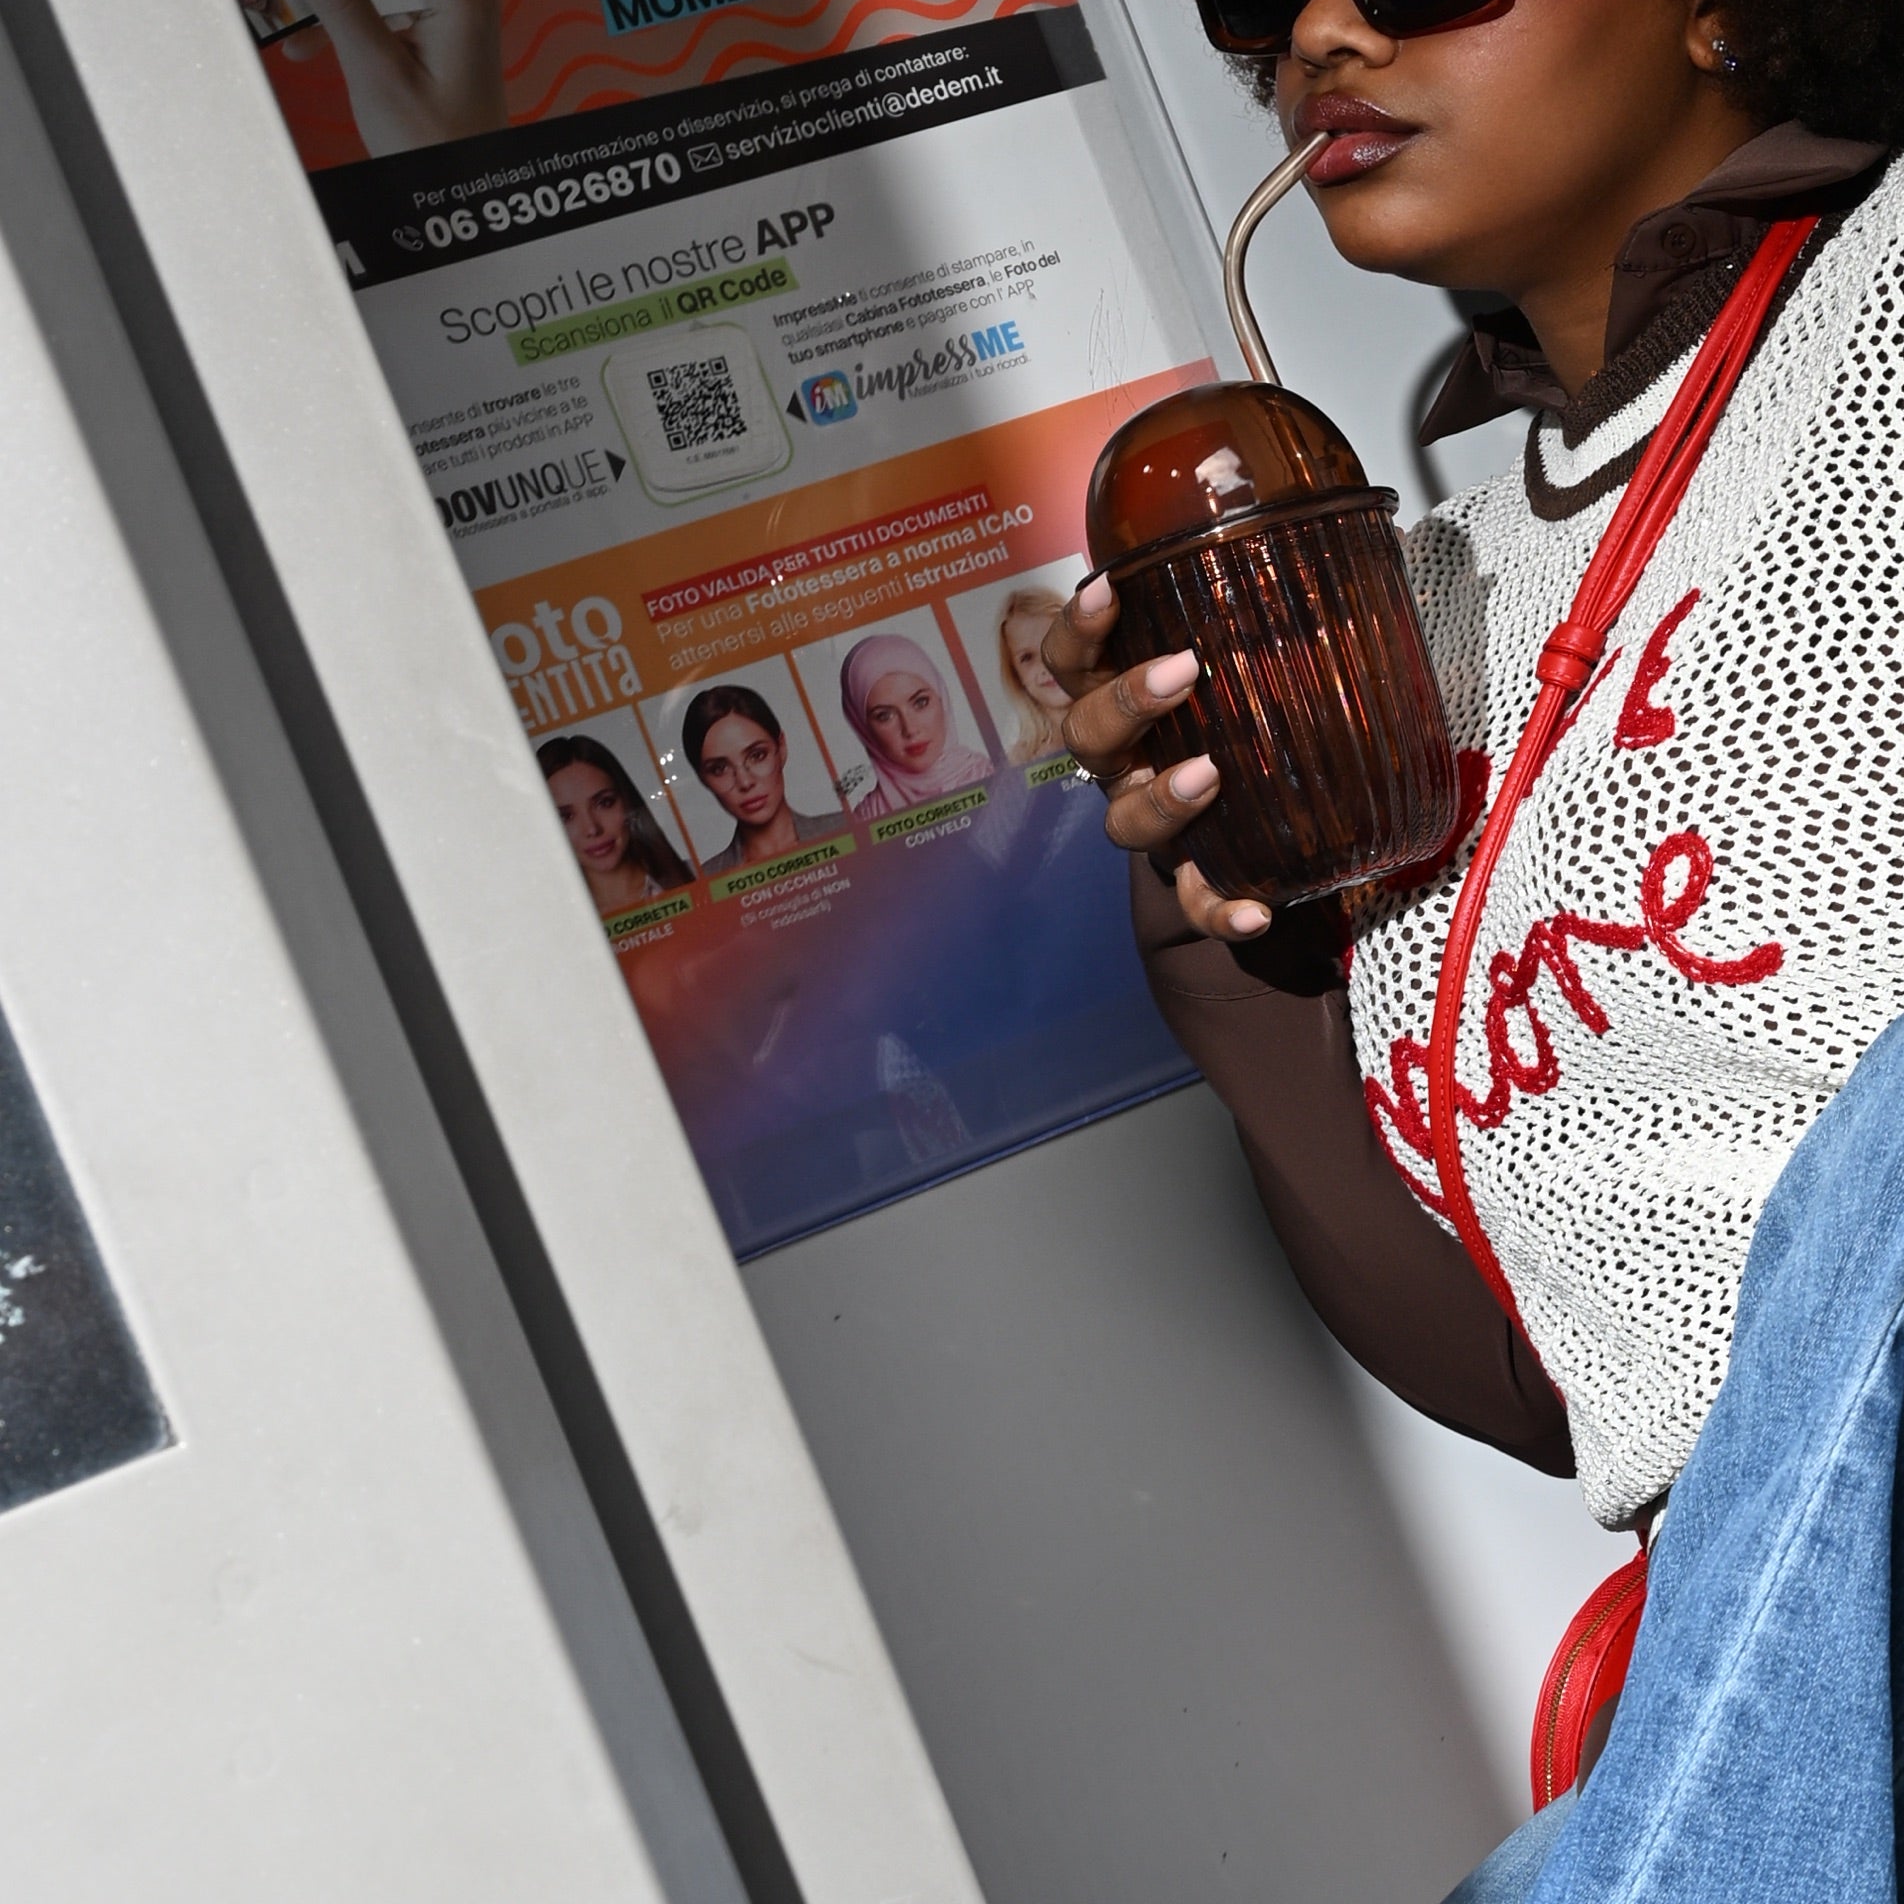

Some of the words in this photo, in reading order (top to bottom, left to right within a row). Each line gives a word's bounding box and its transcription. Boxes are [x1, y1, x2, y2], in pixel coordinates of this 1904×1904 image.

[412, 188, 445, 208] Per
[450, 160, 536, 202] qualsiasi
[536, 130, 659, 174] informazione
[662, 127, 675, 141] o
[677, 98, 780, 137] disservizio,
[780, 89, 797, 109] si
[798, 77, 853, 108] prega
[855, 68, 872, 87] di
[874, 46, 969, 82] contattare:
[425, 209, 479, 247] 06
[482, 152, 681, 231] 93026870
[725, 66, 1003, 159] servizioclienti@dedem.it
[439, 275, 573, 343] Scopri
[575, 269, 615, 305] le
[621, 235, 746, 293] nostre
[757, 203, 834, 255] APP
[845, 302, 898, 326] Cabina
[898, 276, 986, 310] Fototessera,
[988, 270, 1003, 282] le
[1004, 260, 1037, 278] Foto
[1038, 250, 1060, 267] del
[936, 263, 950, 278] di
[951, 245, 1021, 274] stampare,
[1020, 239, 1035, 252] in
[520, 308, 653, 360] Scansiona
[658, 296, 674, 320] il
[676, 286, 717, 314] QR
[719, 268, 787, 301] Code
[787, 348, 813, 364] tuo
[815, 320, 904, 356] smartphone
[906, 318, 915, 328] e
[917, 301, 968, 329] pagare
[969, 293, 996, 309] con
[1007, 278, 1034, 298] APP
[854, 321, 1024, 401] impressME
[482, 388, 541, 414] trovare
[541, 383, 557, 396] le
[557, 376, 580, 392] tre
[559, 402, 570, 413] a
[570, 396, 588, 409] te
[564, 412, 593, 434] APP
[646, 587, 700, 617] FOTO
[700, 564, 774, 598] VALIDA
[772, 551, 810, 577] PER
[809, 532, 867, 562] TUTTI
[867, 529, 875, 544] I
[876, 492, 988, 542] DOCUMENTI
[656, 617, 694, 643] Per
[700, 603, 743, 629] una
[745, 557, 883, 614] Fototessera
[886, 552, 901, 568] a
[903, 527, 976, 562] norma
[977, 503, 1034, 537] ICAO
[669, 621, 766, 670] attenersi
[769, 611, 809, 636] alle
[811, 575, 903, 623] seguenti
[903, 540, 1009, 591] istruzioni
[1031, 763, 1065, 782] FOTO
[877, 817, 914, 839] FOTO
[915, 791, 986, 825] CORRETTA
[905, 828, 935, 848] CON
[935, 815, 971, 836] VELO
[727, 871, 765, 893] FOTO
[766, 845, 839, 879] CORRETTA
[740, 887, 773, 907] CON
[774, 863, 838, 895] OCCHIALI
[613, 899, 689, 934] CORRETTA
